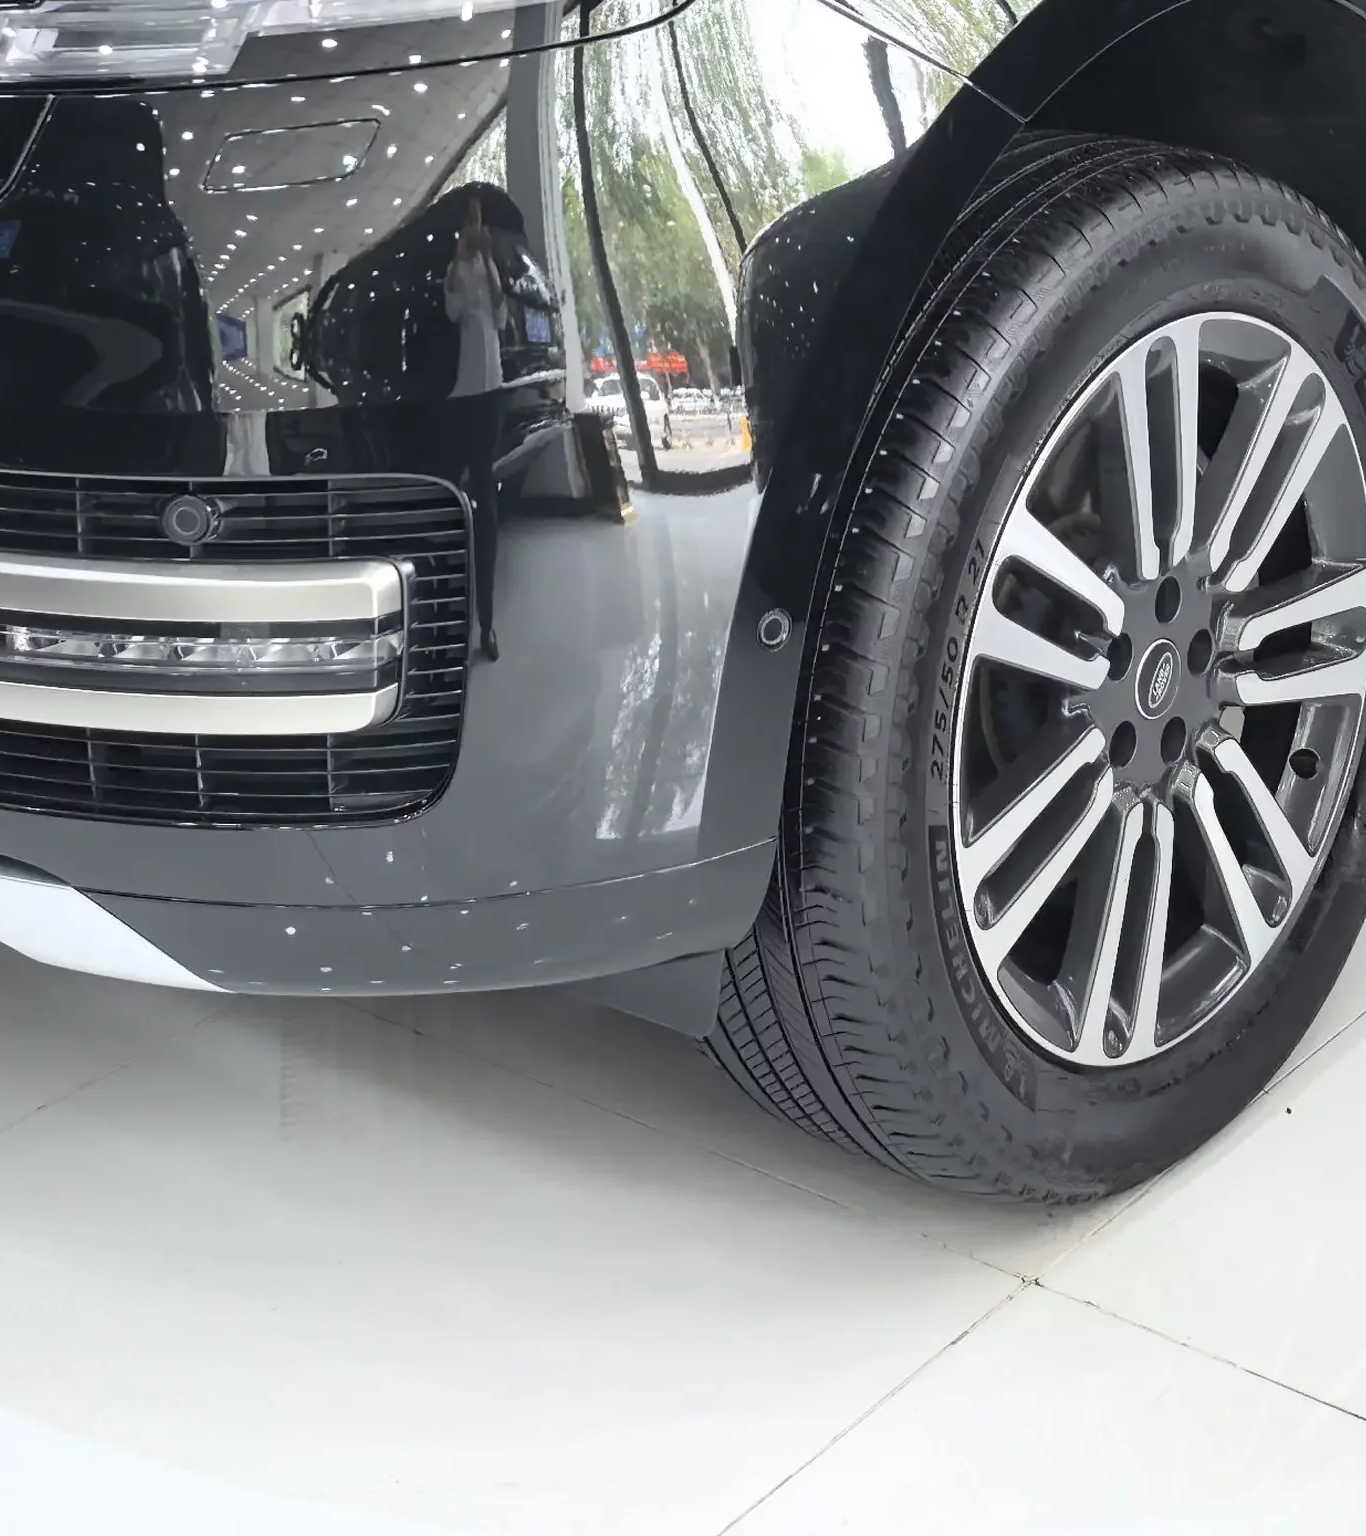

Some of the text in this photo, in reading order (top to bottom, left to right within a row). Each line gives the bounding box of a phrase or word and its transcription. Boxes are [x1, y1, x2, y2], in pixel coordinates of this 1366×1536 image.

[931, 636, 958, 781] 275/50
[968, 538, 985, 585] 21
[934, 841, 1003, 1054] MICHELIN
